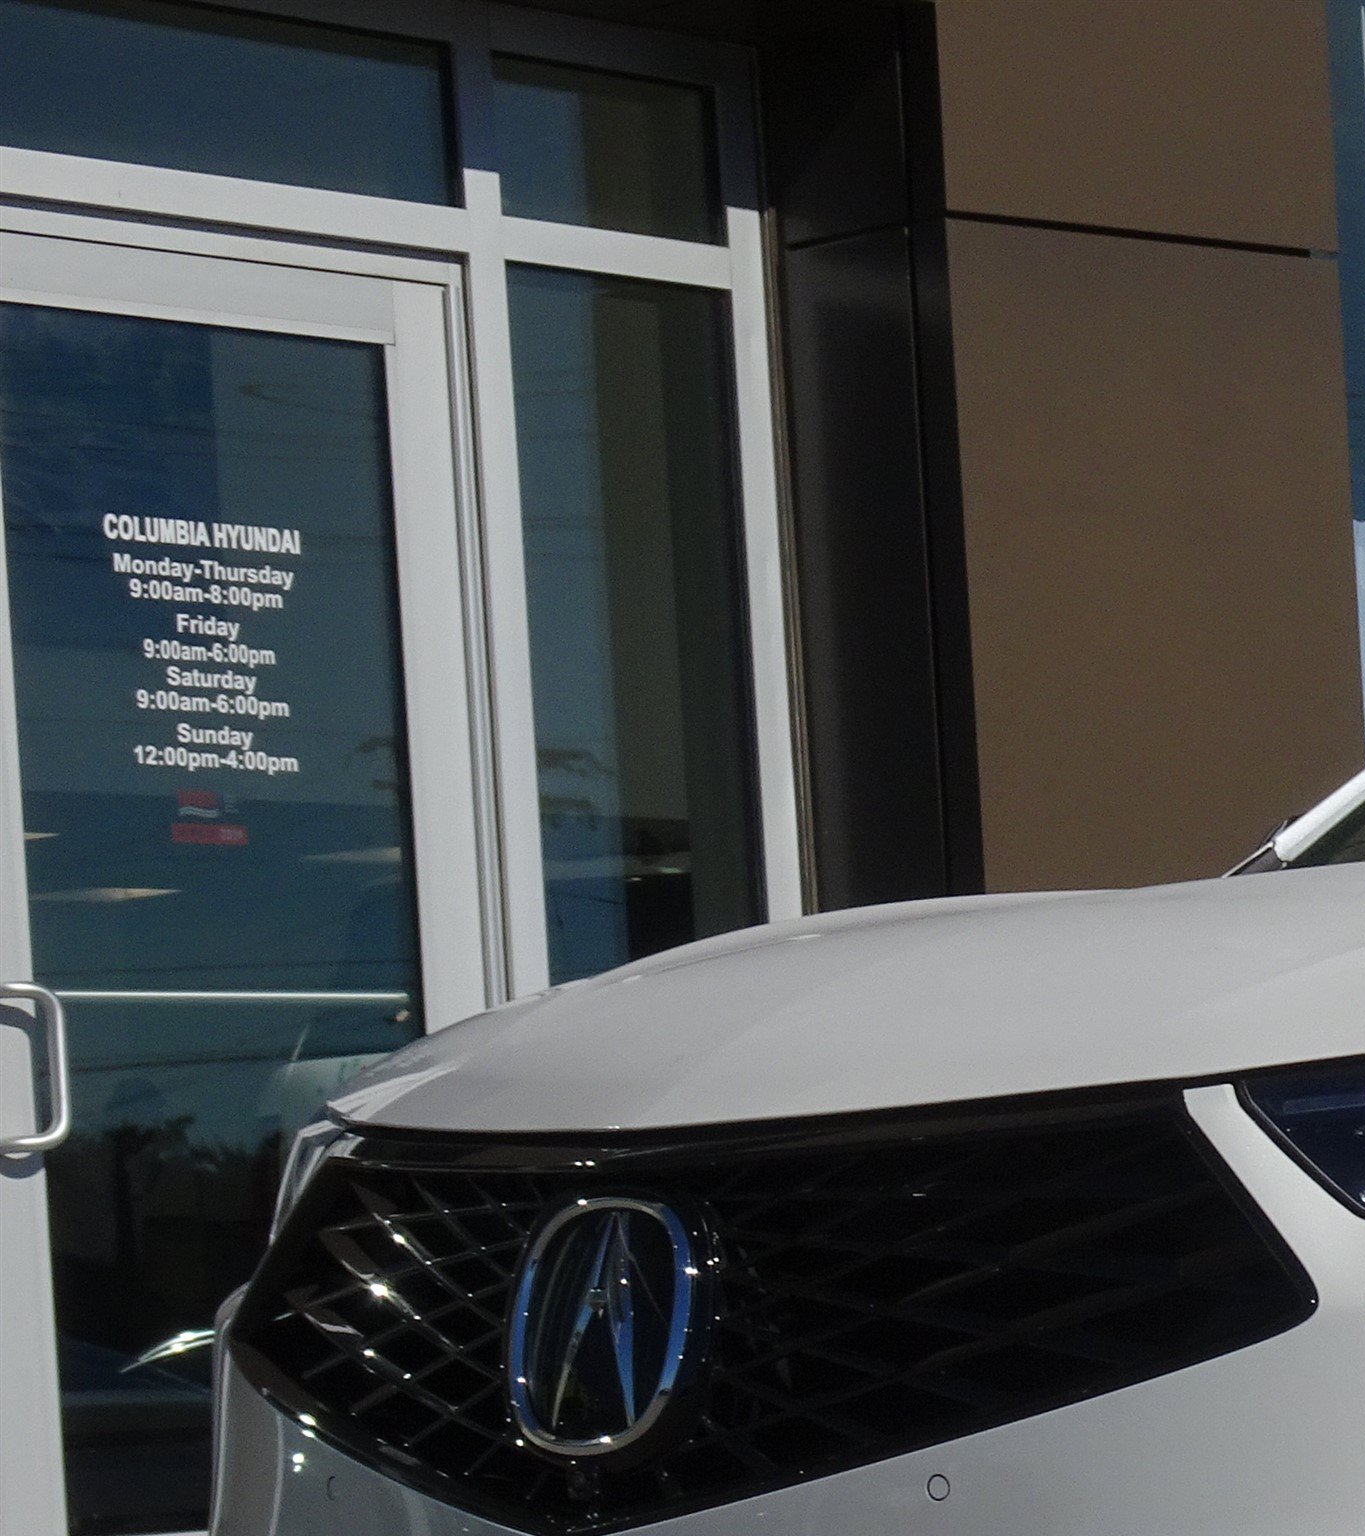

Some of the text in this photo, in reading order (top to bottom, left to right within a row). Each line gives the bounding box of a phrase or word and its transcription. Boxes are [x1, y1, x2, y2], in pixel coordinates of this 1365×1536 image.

[103, 513, 301, 555] COLUMBIA HYUNDAI
[112, 552, 295, 591] Monday-Thursday
[129, 578, 284, 612] 9:00am-8:00pm
[176, 613, 240, 642] Friday
[143, 638, 277, 668] 9:00am-6:00pm
[166, 665, 257, 695] Saturday
[136, 688, 290, 720] 9:00am-6:00pm
[176, 722, 253, 750] Sunday
[133, 744, 300, 776] 12:00pm-4:00pm
